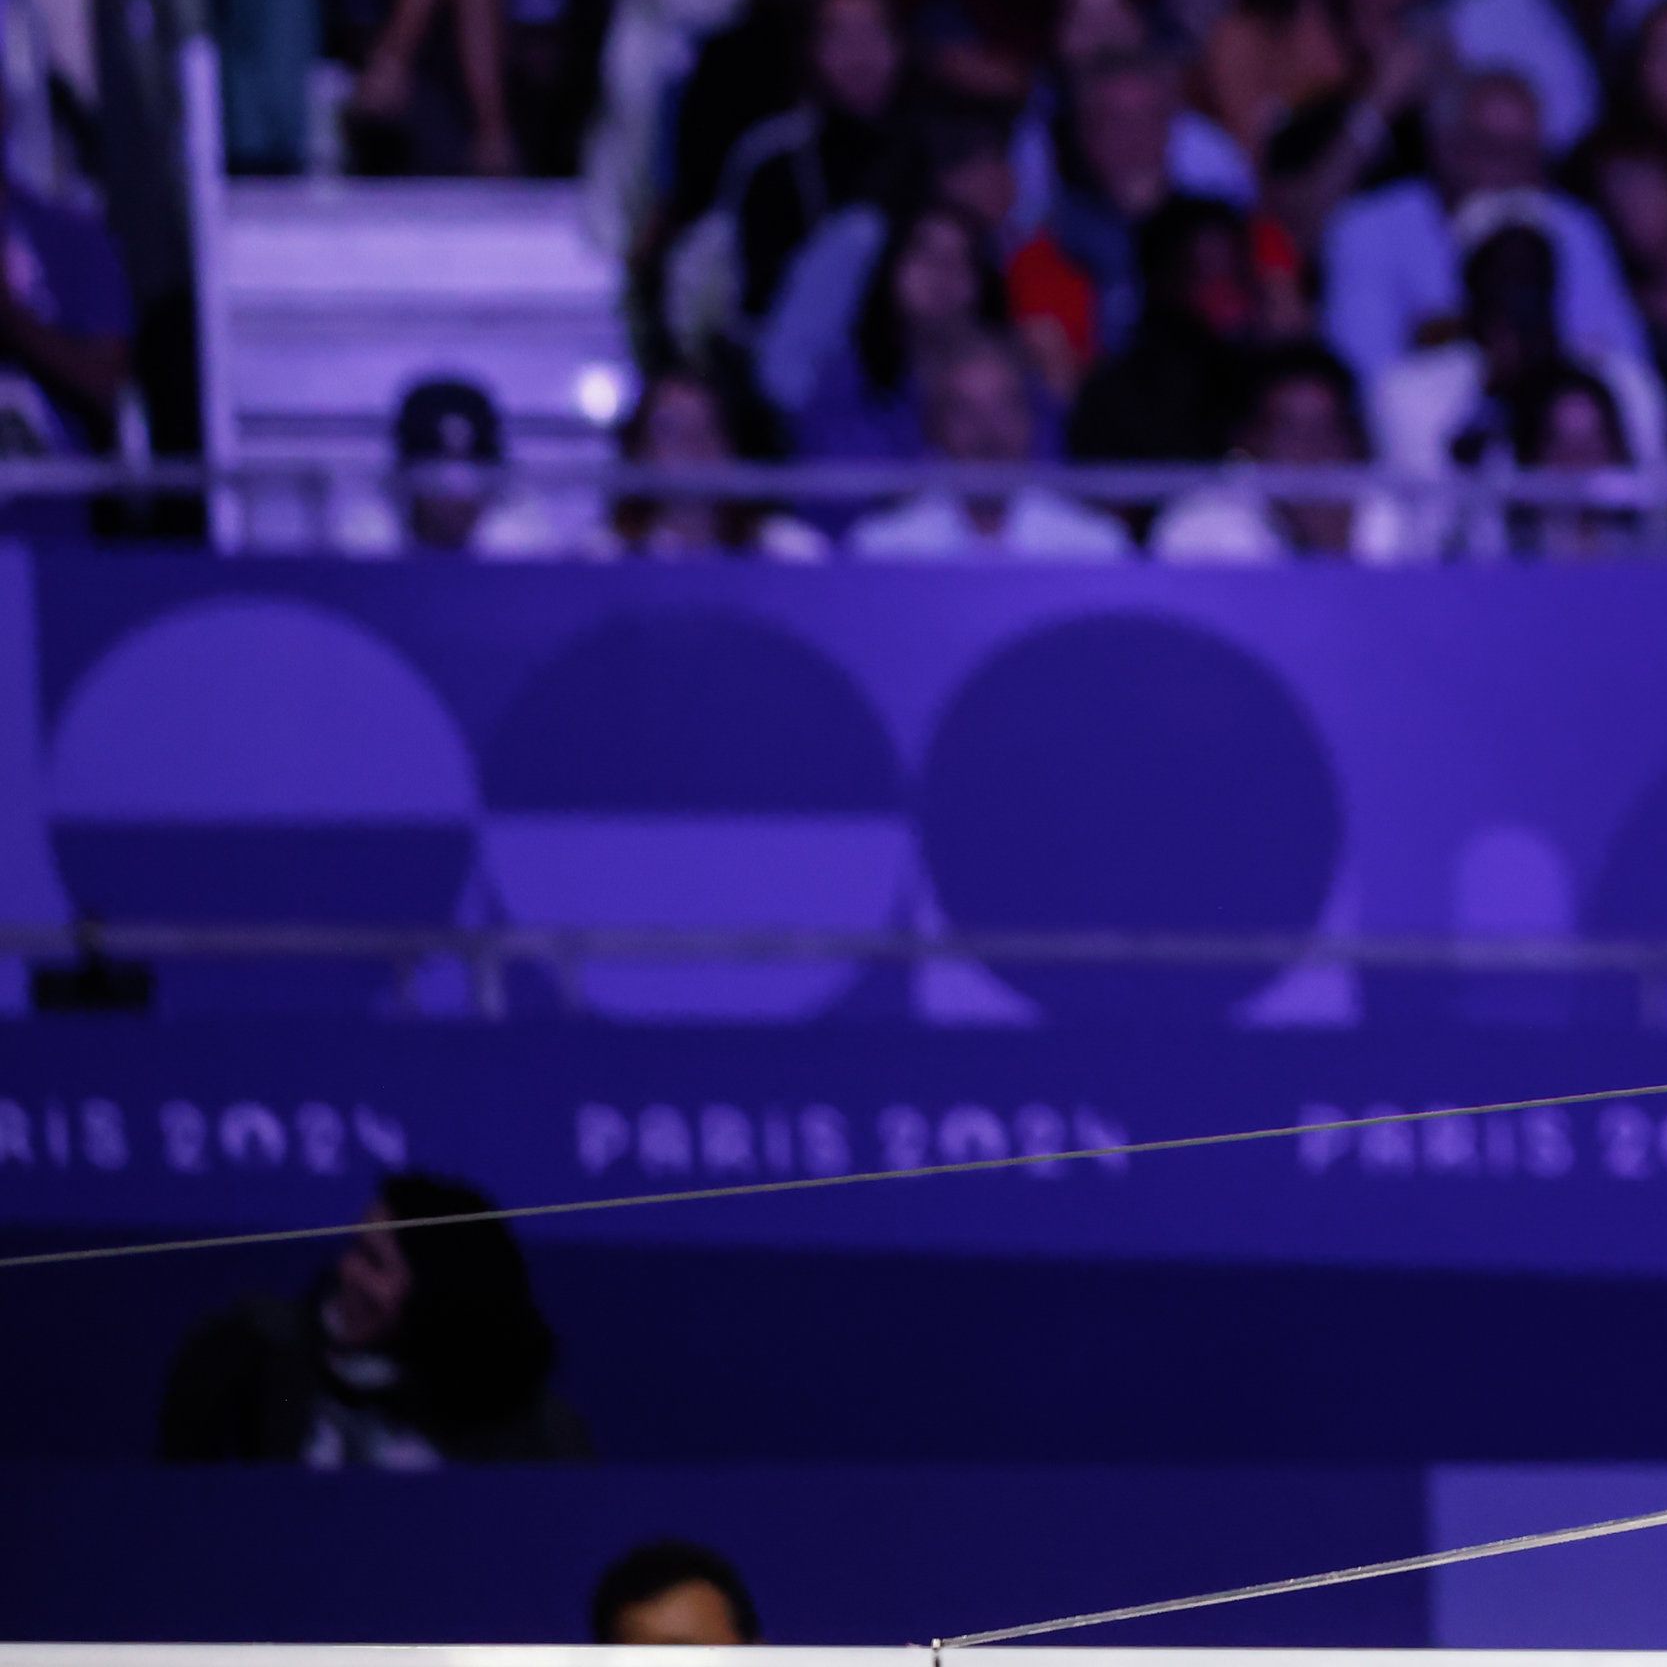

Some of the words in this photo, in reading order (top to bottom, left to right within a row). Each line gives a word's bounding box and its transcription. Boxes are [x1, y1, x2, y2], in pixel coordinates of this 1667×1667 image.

[575, 1102, 851, 1177] PARIS
[877, 1102, 1128, 1182] 2024
[1300, 1102, 1575, 1179] PARIS
